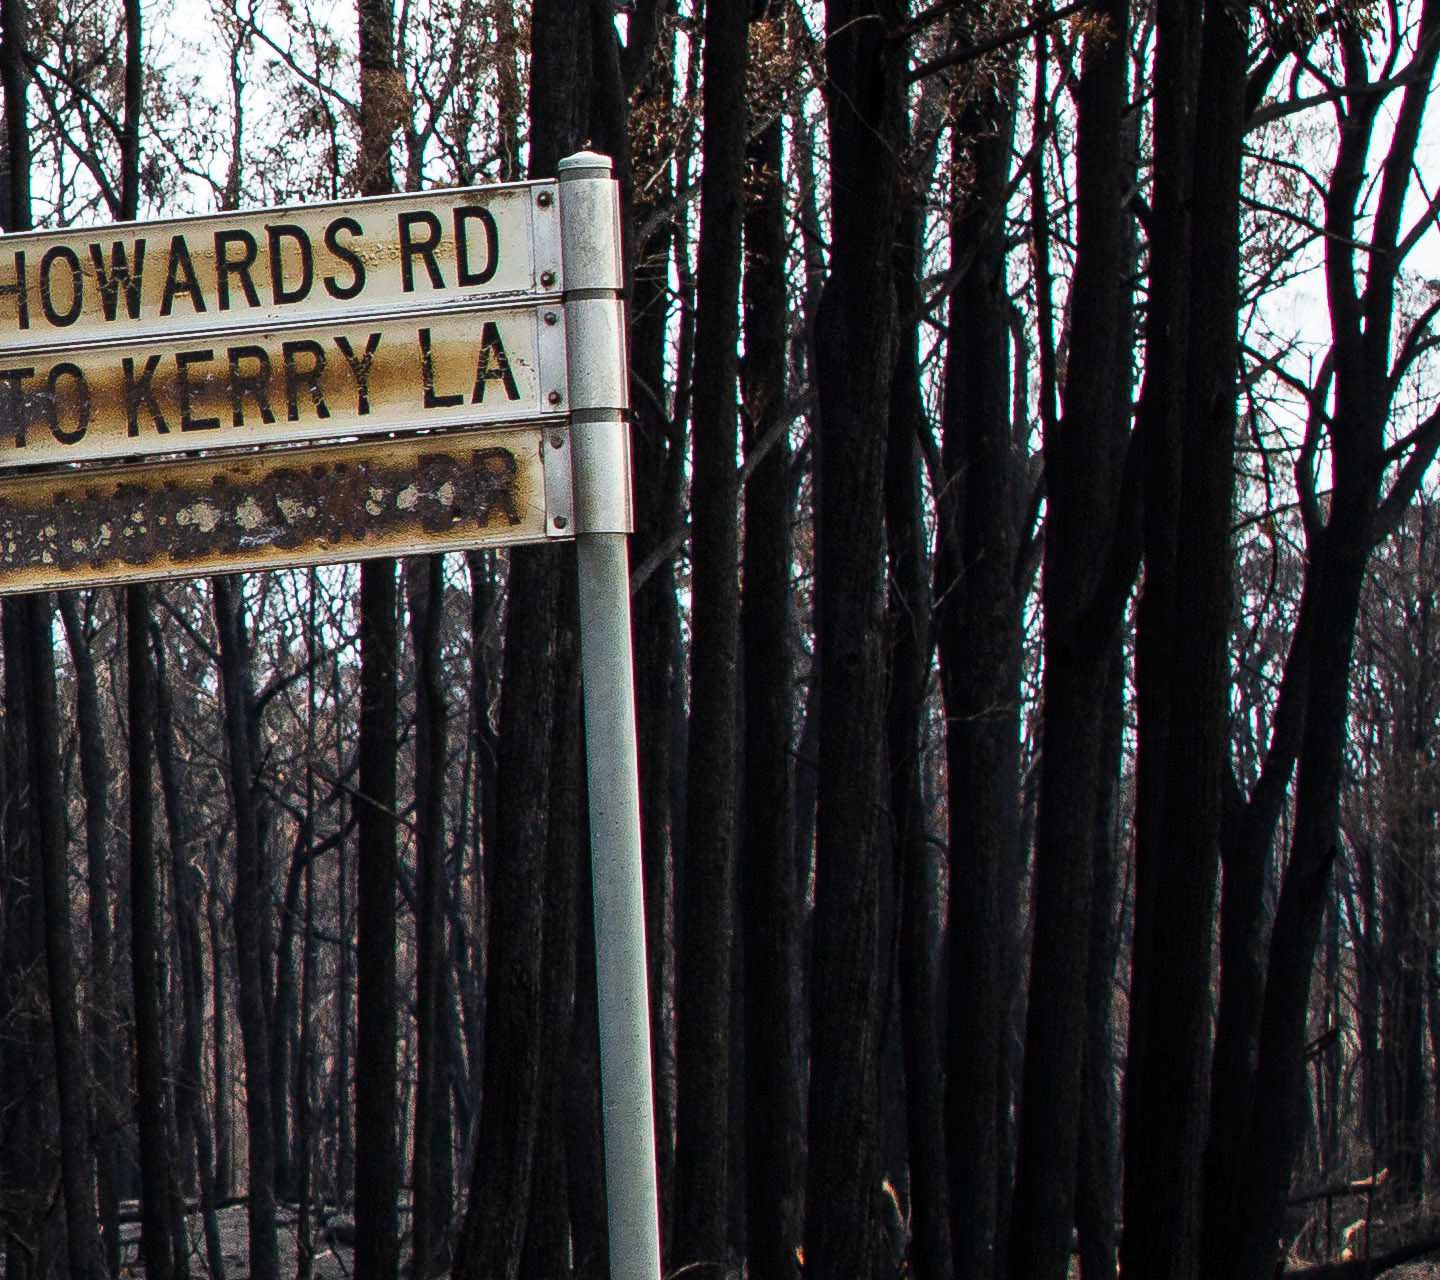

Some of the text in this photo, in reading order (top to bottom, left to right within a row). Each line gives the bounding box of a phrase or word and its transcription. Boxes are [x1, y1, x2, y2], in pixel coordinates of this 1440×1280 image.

[397, 205, 500, 294] RD
[121, 332, 382, 438] KERRY
[417, 320, 522, 409] LA
